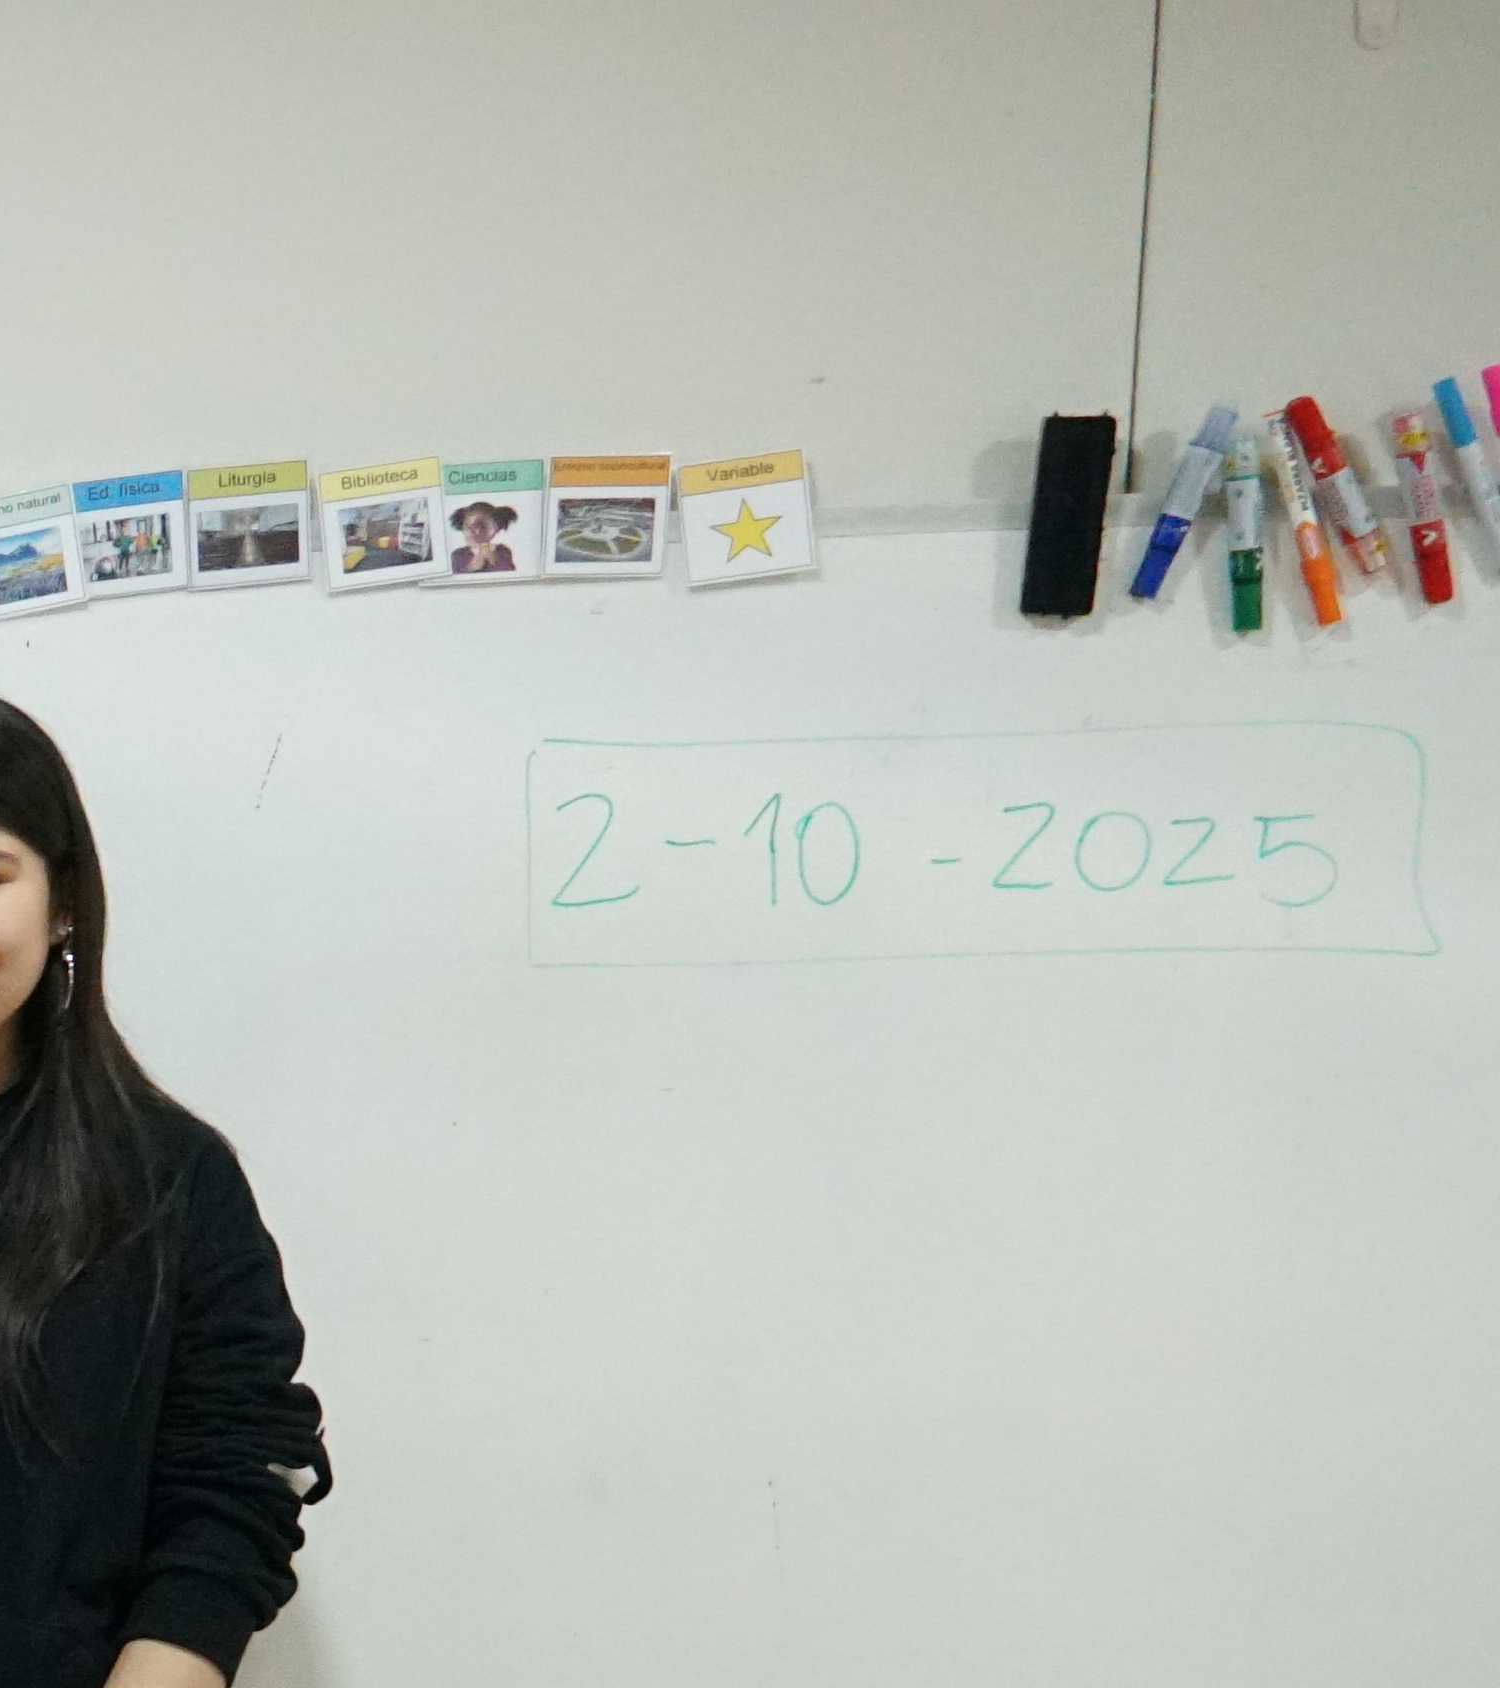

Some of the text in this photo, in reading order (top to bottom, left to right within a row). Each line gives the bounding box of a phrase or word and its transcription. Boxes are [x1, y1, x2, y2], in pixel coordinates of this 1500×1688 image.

[218, 470, 276, 488] Liturgia
[341, 468, 418, 490] Biblioteca
[449, 471, 518, 484] Ciencias
[707, 462, 775, 481] Variable
[17, 491, 62, 513] natural
